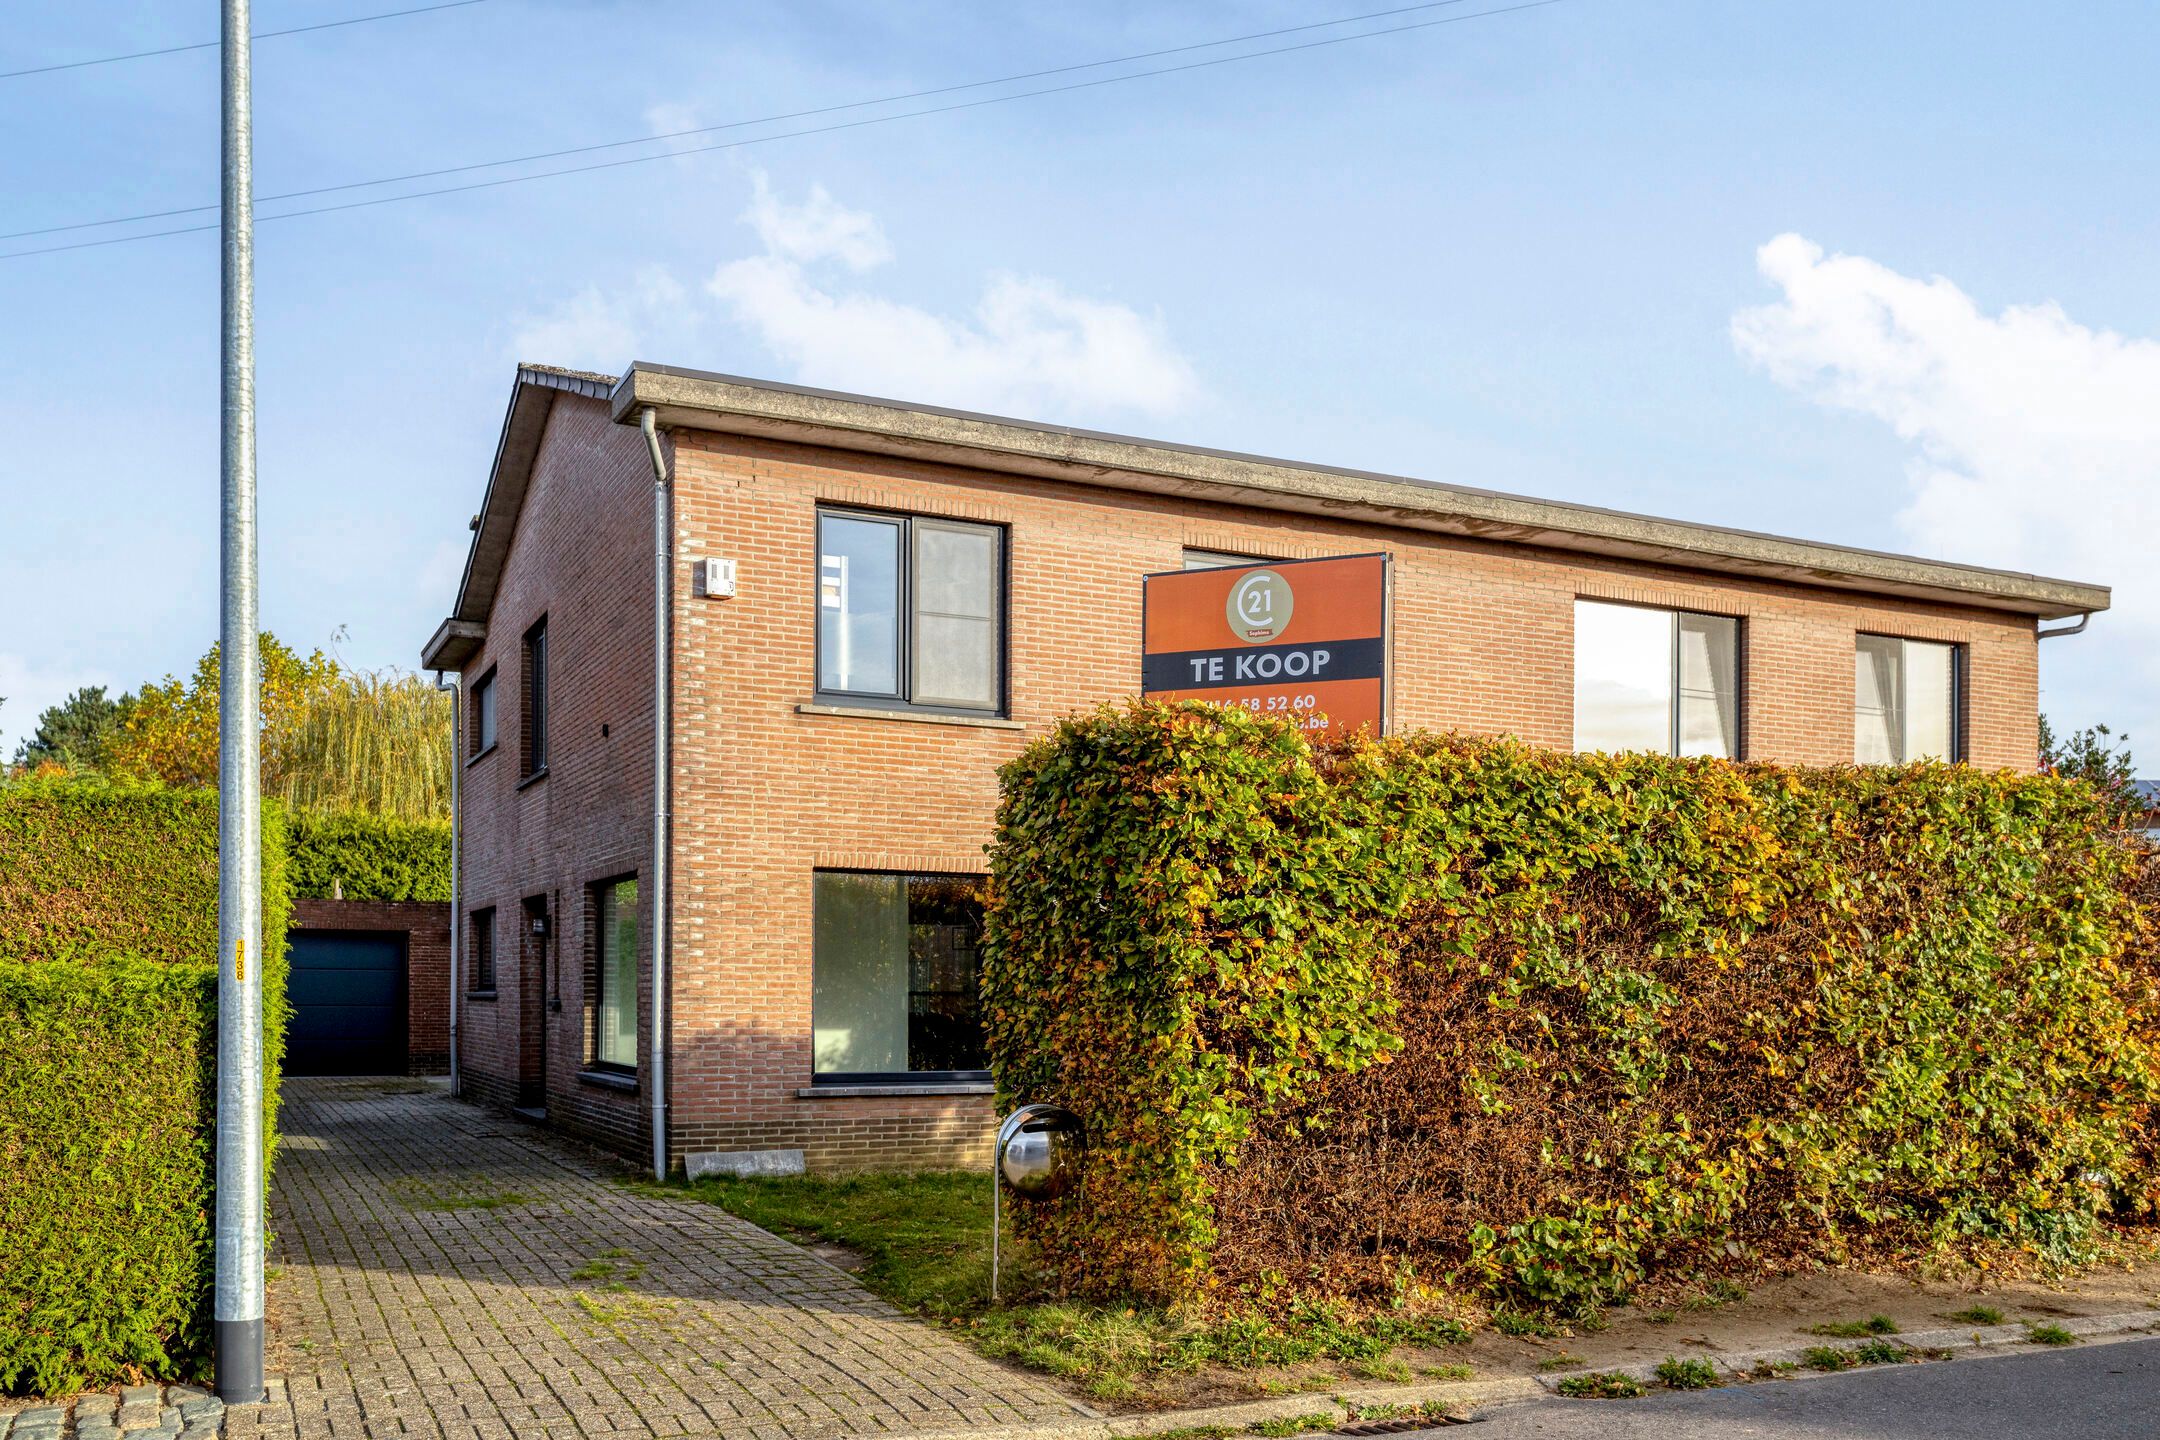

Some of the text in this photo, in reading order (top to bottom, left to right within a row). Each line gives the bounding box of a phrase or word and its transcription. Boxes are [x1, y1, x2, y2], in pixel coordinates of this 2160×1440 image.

[1190, 650, 1330, 682] TE KOOP
[1266, 696, 1288, 710] 52
[1293, 694, 1316, 709] 60
[236, 940, 244, 980] 1738
